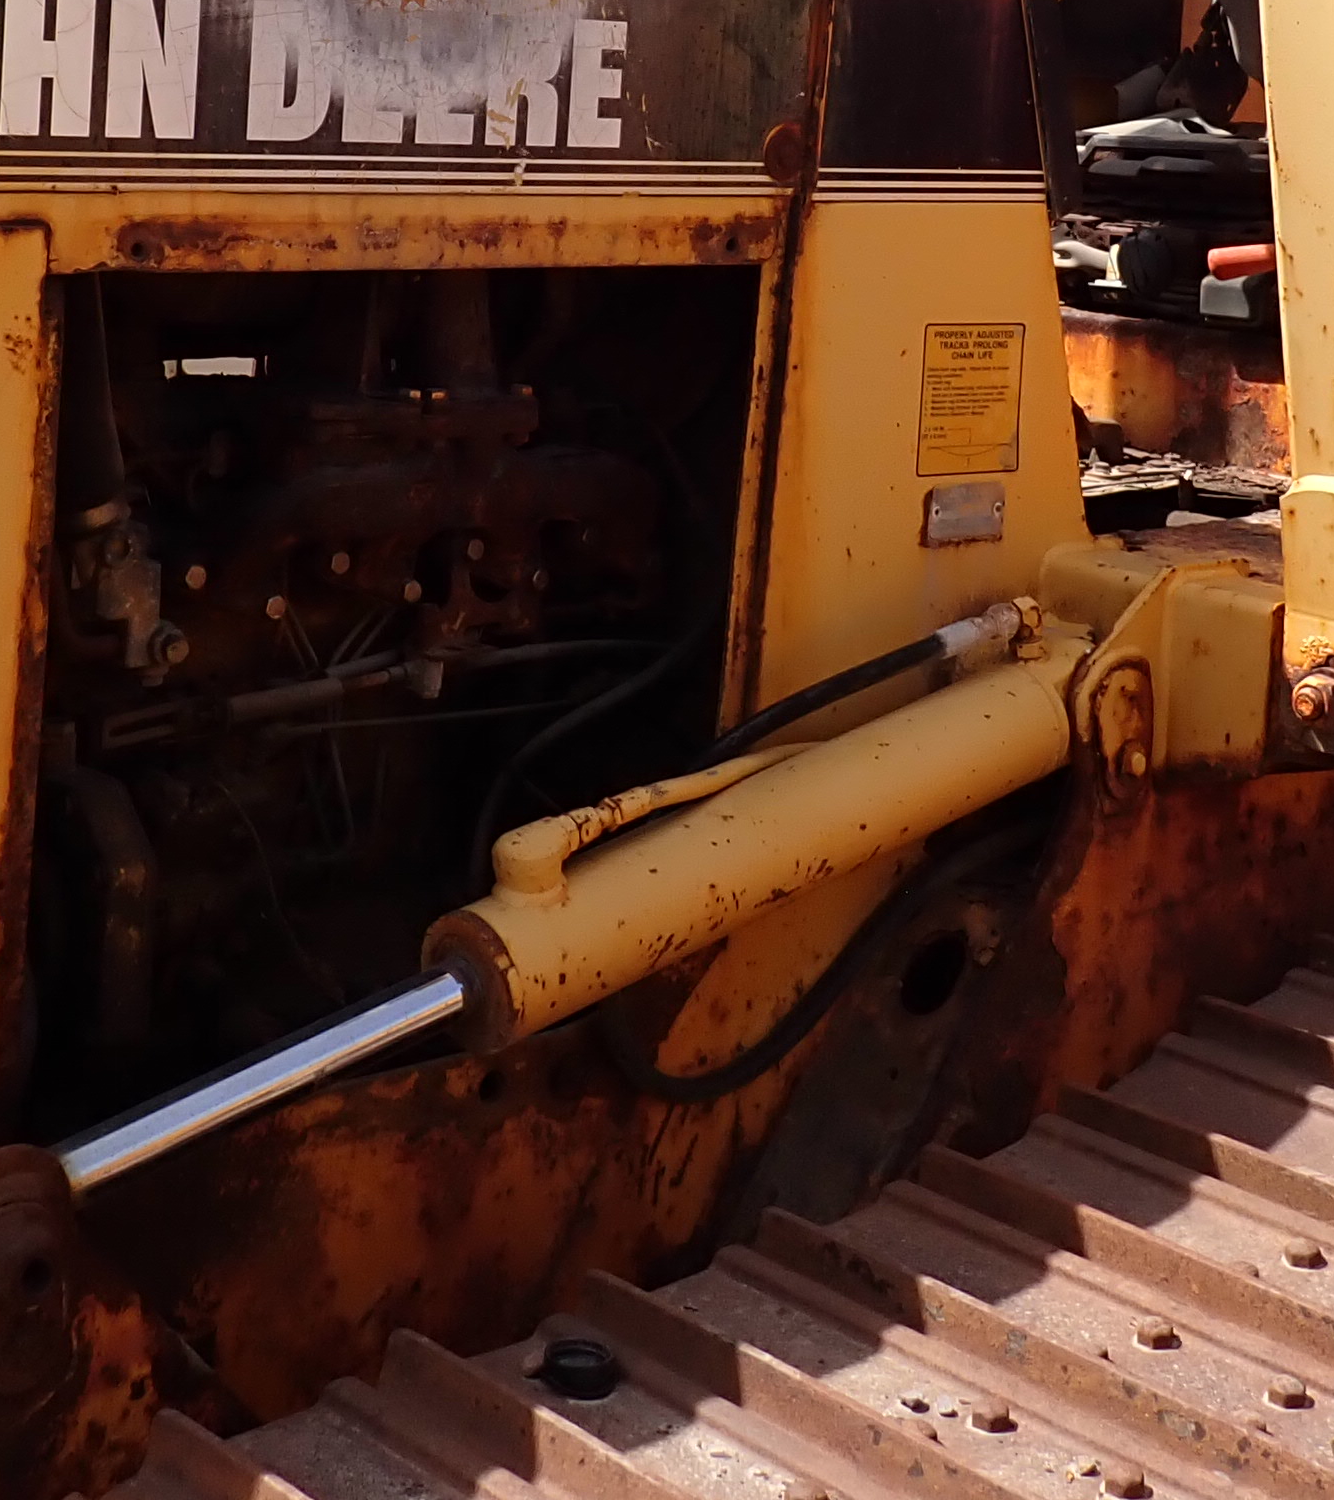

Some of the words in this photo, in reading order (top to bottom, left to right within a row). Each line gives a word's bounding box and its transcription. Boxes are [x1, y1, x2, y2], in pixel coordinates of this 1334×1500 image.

[934, 330, 974, 340] PROPERLY
[976, 329, 1015, 340] ADJUSTED
[972, 340, 1009, 350] PROLONG
